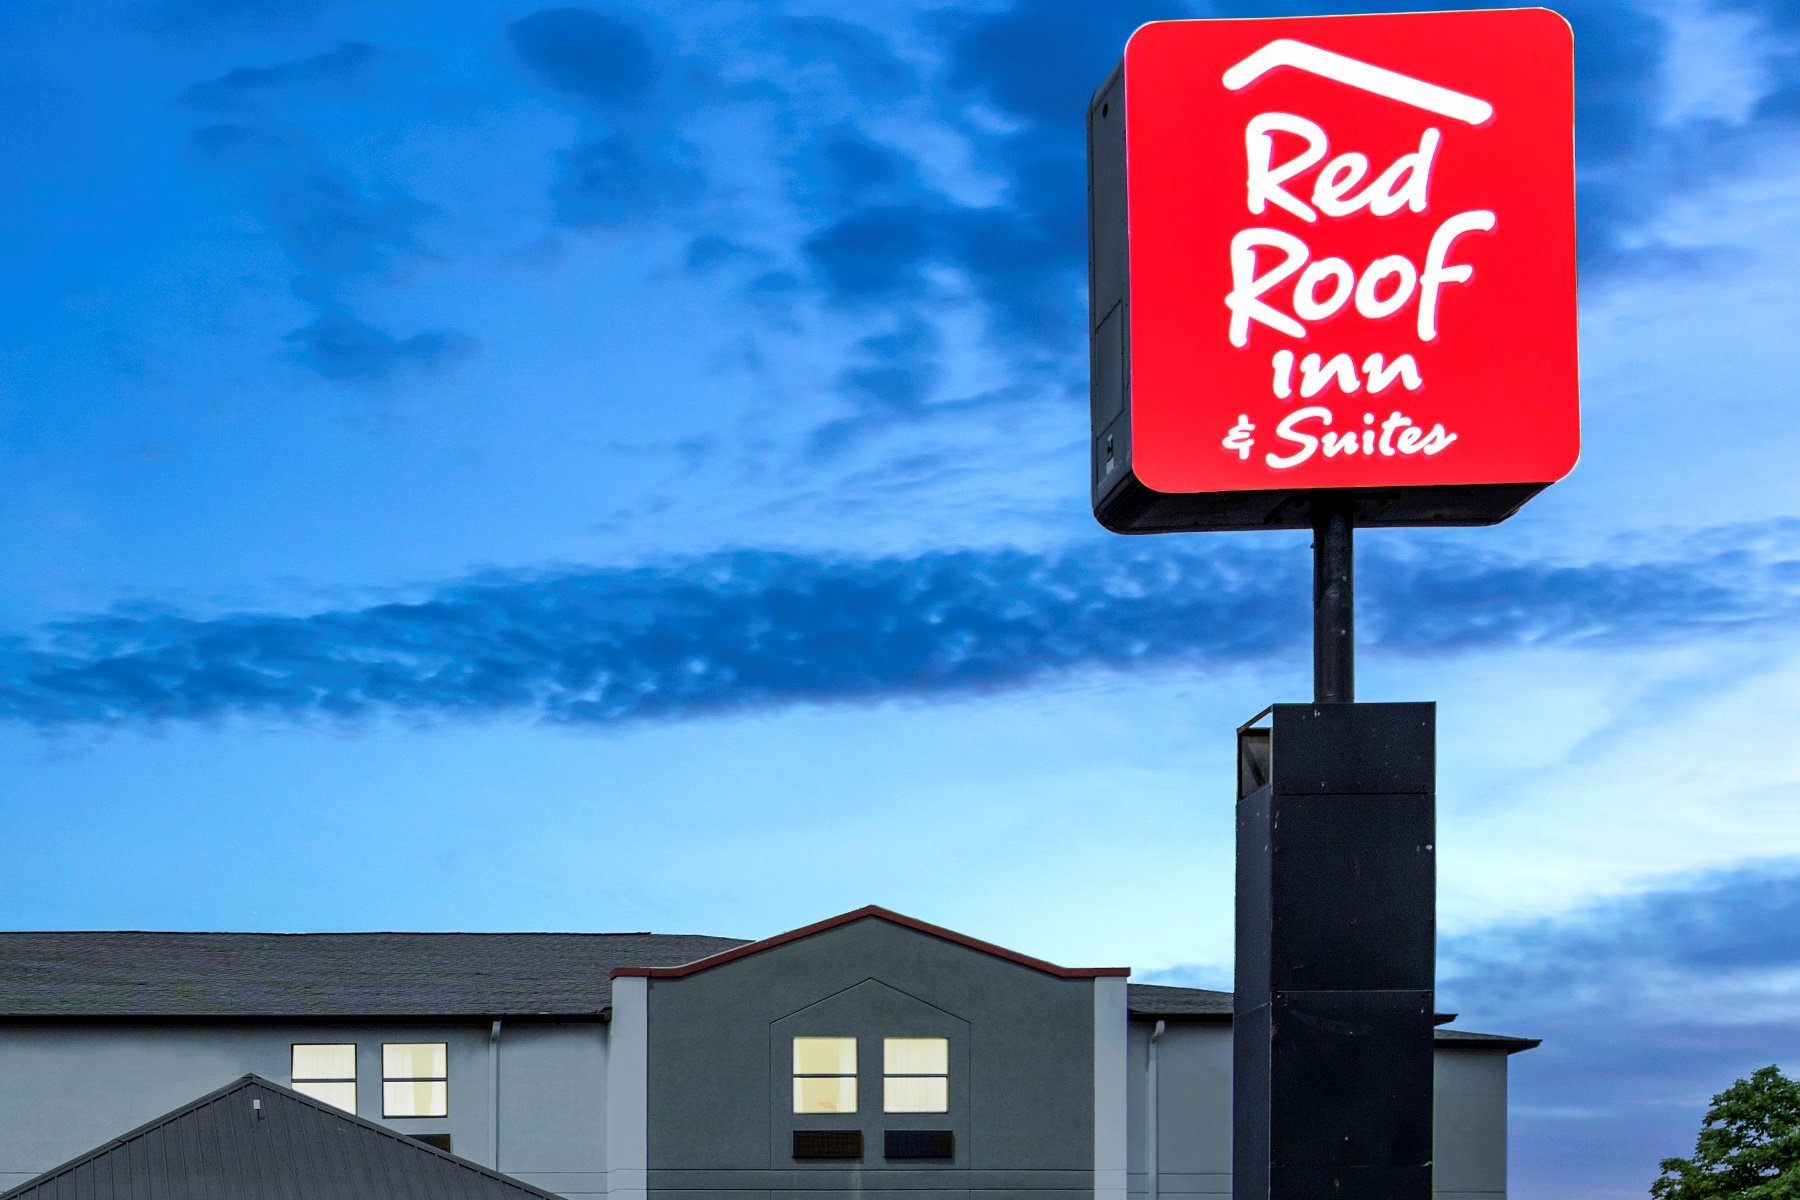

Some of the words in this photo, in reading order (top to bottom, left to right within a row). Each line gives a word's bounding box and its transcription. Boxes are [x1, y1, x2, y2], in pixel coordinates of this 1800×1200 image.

[1245, 111, 1441, 223] Red
[1224, 209, 1497, 348] Roof
[1221, 413, 1256, 461] &
[1265, 406, 1458, 469] Suites
